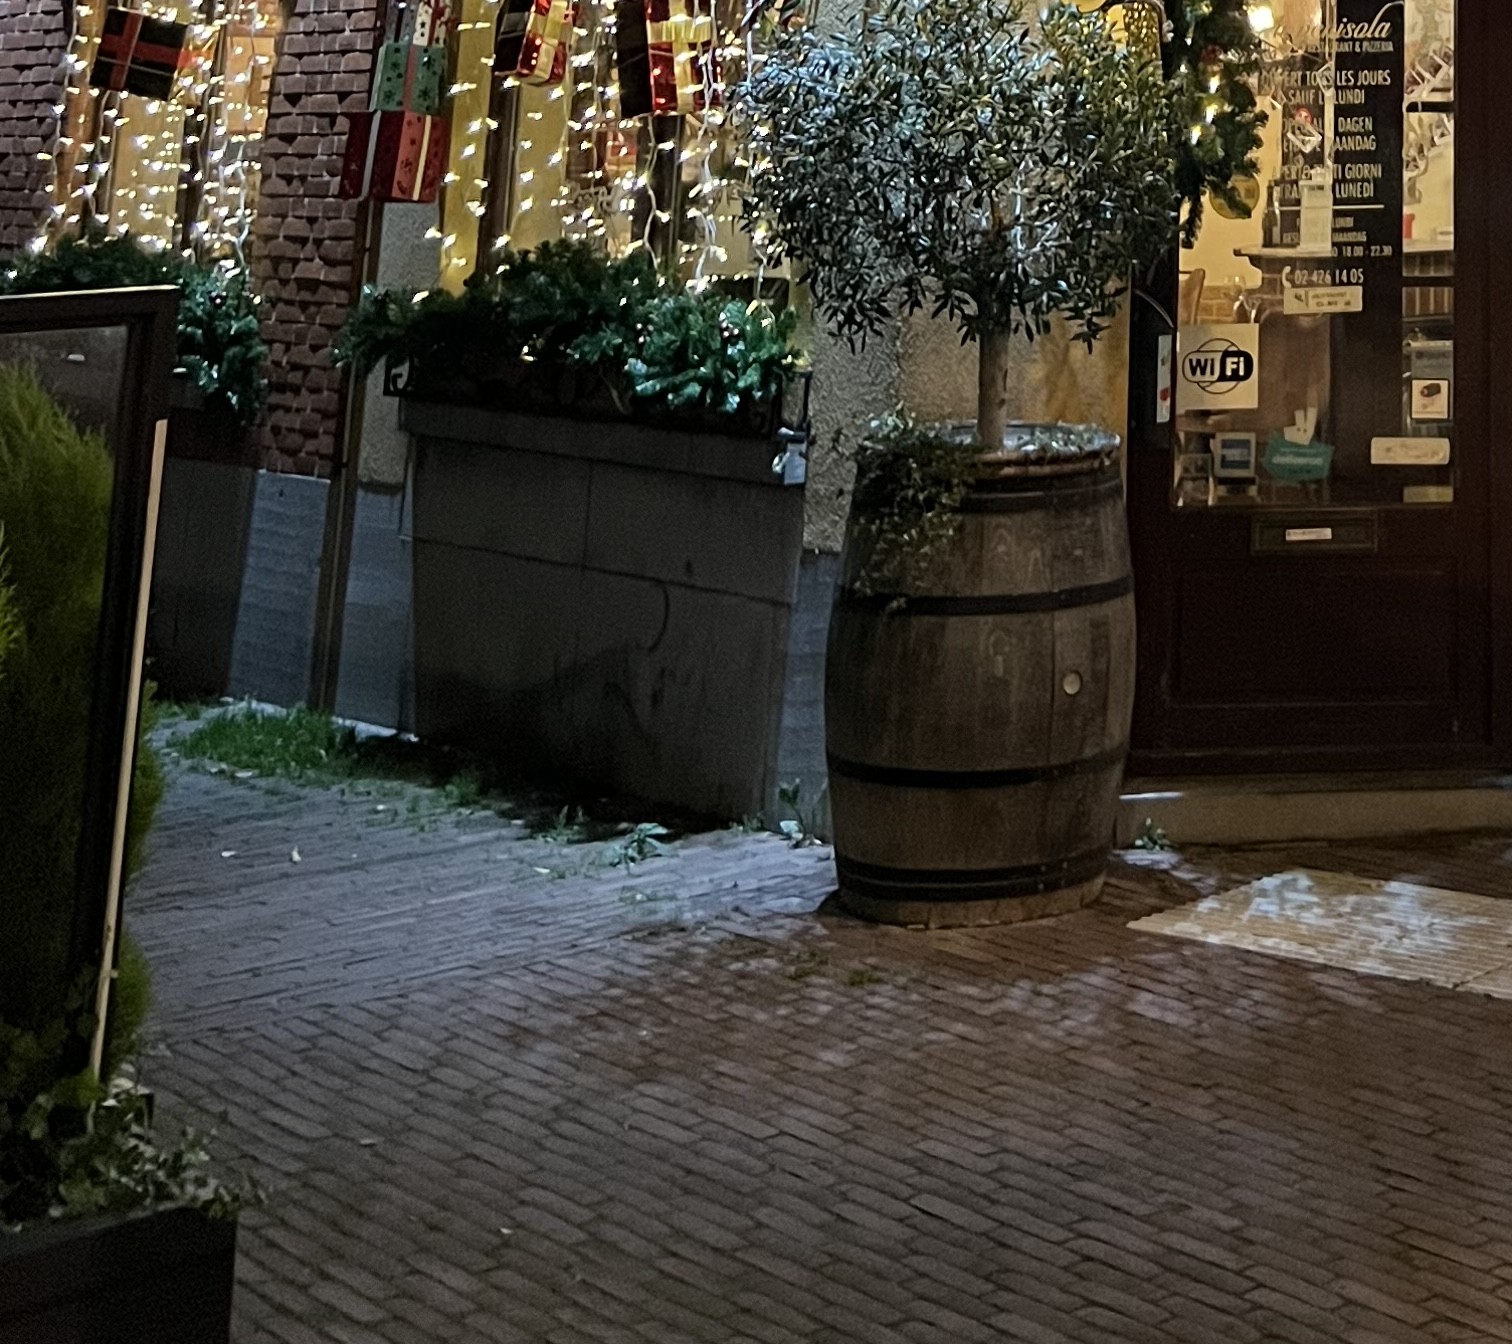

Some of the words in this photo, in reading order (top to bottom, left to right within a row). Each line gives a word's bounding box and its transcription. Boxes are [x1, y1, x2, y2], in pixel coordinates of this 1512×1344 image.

[1336, 70, 1355, 86] LES
[1357, 69, 1392, 86] JOURS
[1288, 90, 1315, 105] SAUF
[1333, 89, 1365, 105] LUNDI
[1338, 117, 1373, 133] DAGEN
[1345, 164, 1382, 179] GIORNI
[1294, 269, 1309, 285] 02
[1311, 268, 1332, 285] 426
[1335, 268, 1348, 284] 14
[1350, 267, 1364, 284] 05
